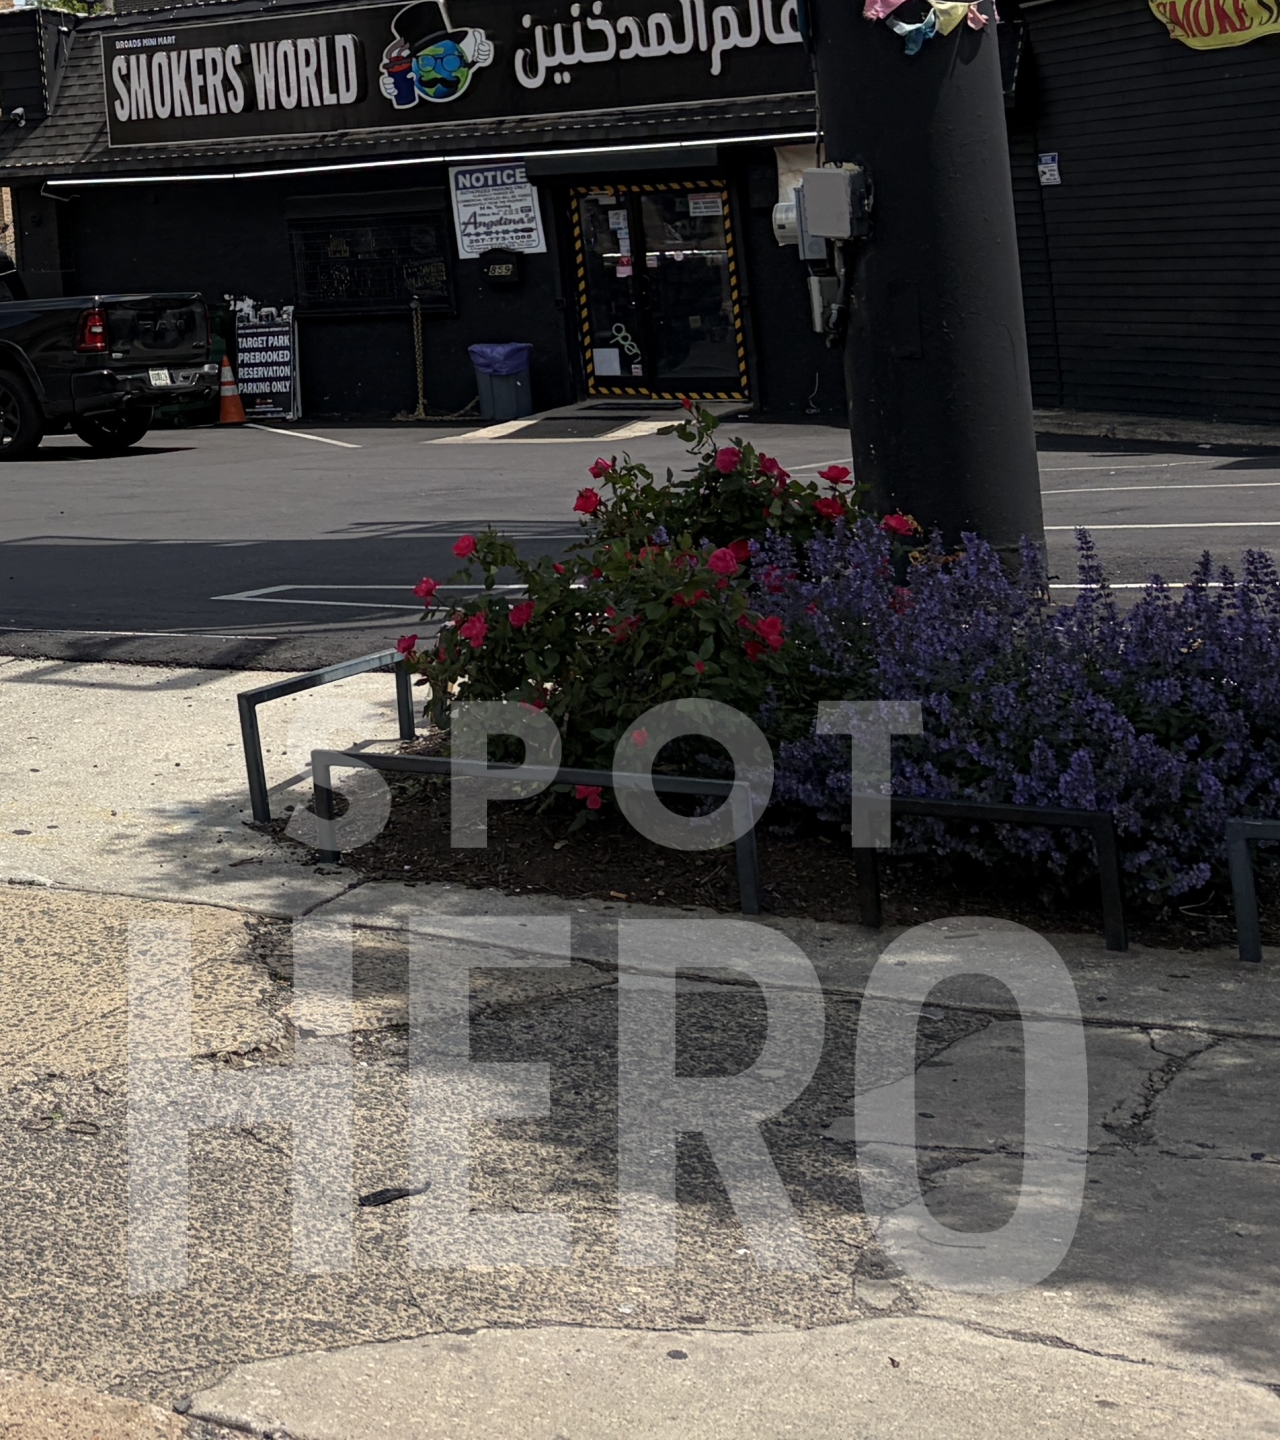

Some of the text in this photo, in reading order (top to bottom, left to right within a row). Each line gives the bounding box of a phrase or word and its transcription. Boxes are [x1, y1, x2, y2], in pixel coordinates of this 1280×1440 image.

[112, 33, 359, 122] SMOKERS WORLD
[457, 167, 528, 189] NOTICE
[237, 335, 290, 349] TARGET PARK
[238, 350, 290, 364] PREBOOKED
[238, 365, 291, 379] RESERVATION
[238, 380, 291, 394] PARKING ONLY
